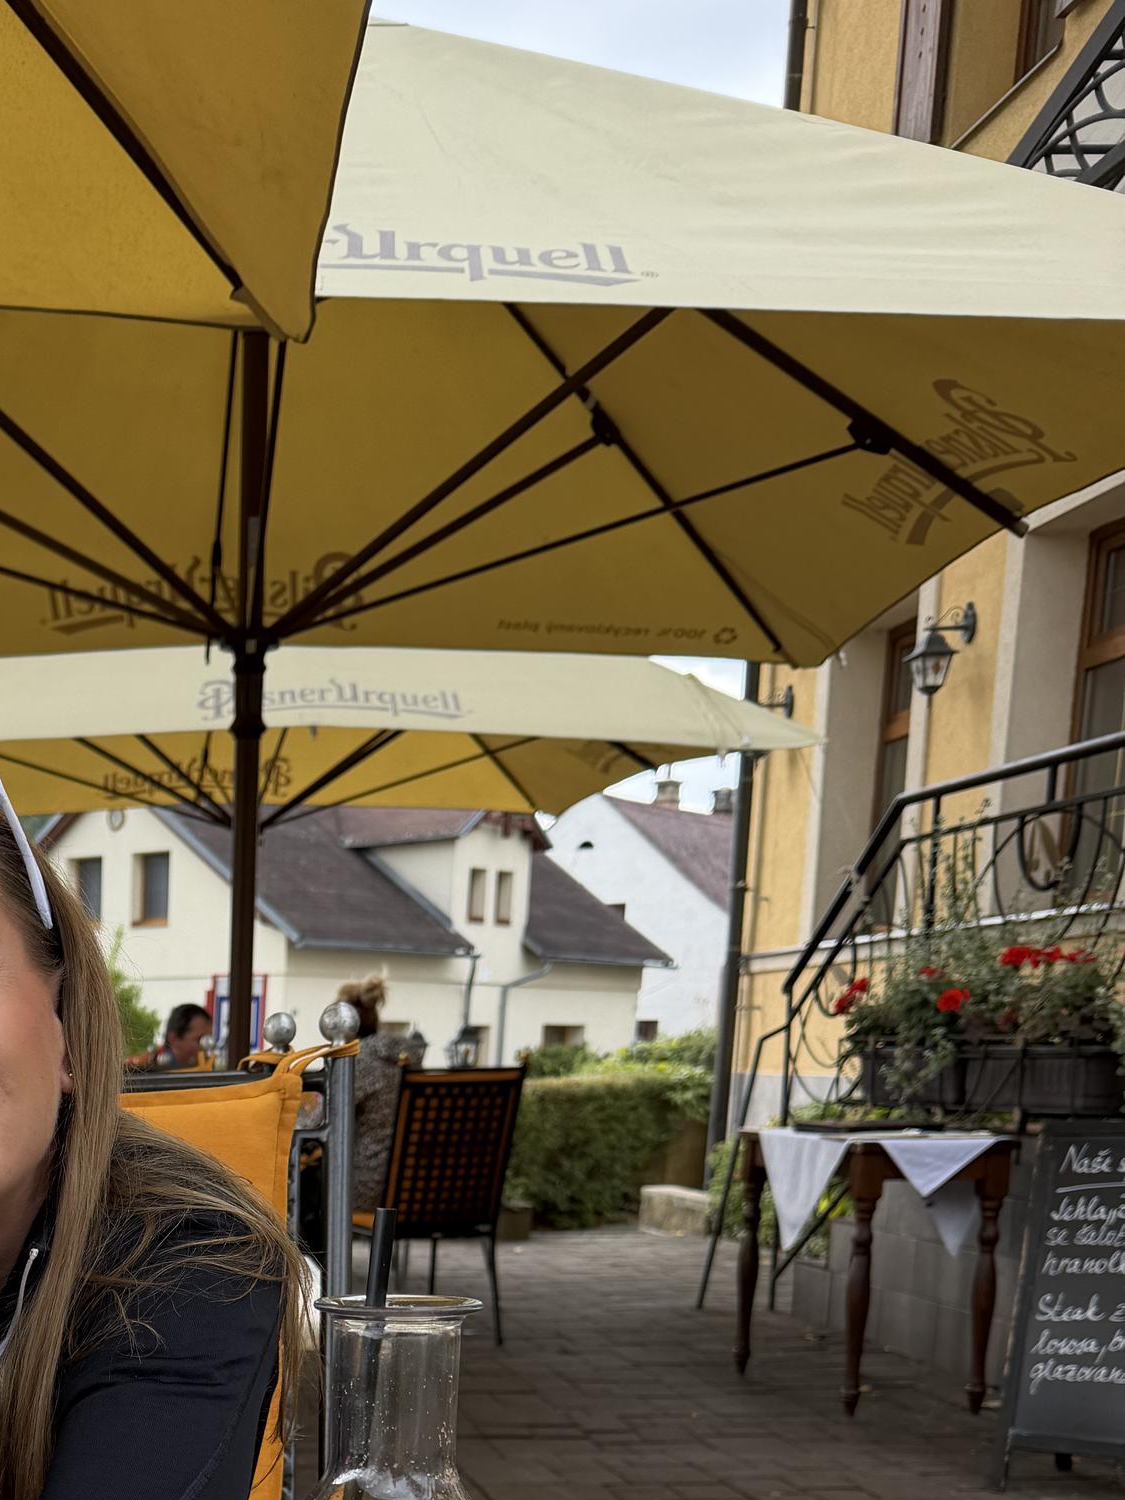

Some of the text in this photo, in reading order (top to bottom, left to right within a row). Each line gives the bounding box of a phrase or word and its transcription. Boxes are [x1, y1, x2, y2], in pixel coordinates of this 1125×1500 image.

[331, 223, 633, 282] Urquell
[196, 678, 462, 720] Psner Urquell
[1059, 1142, 1113, 1174] Naše
[1035, 1291, 1106, 1322] Steak
